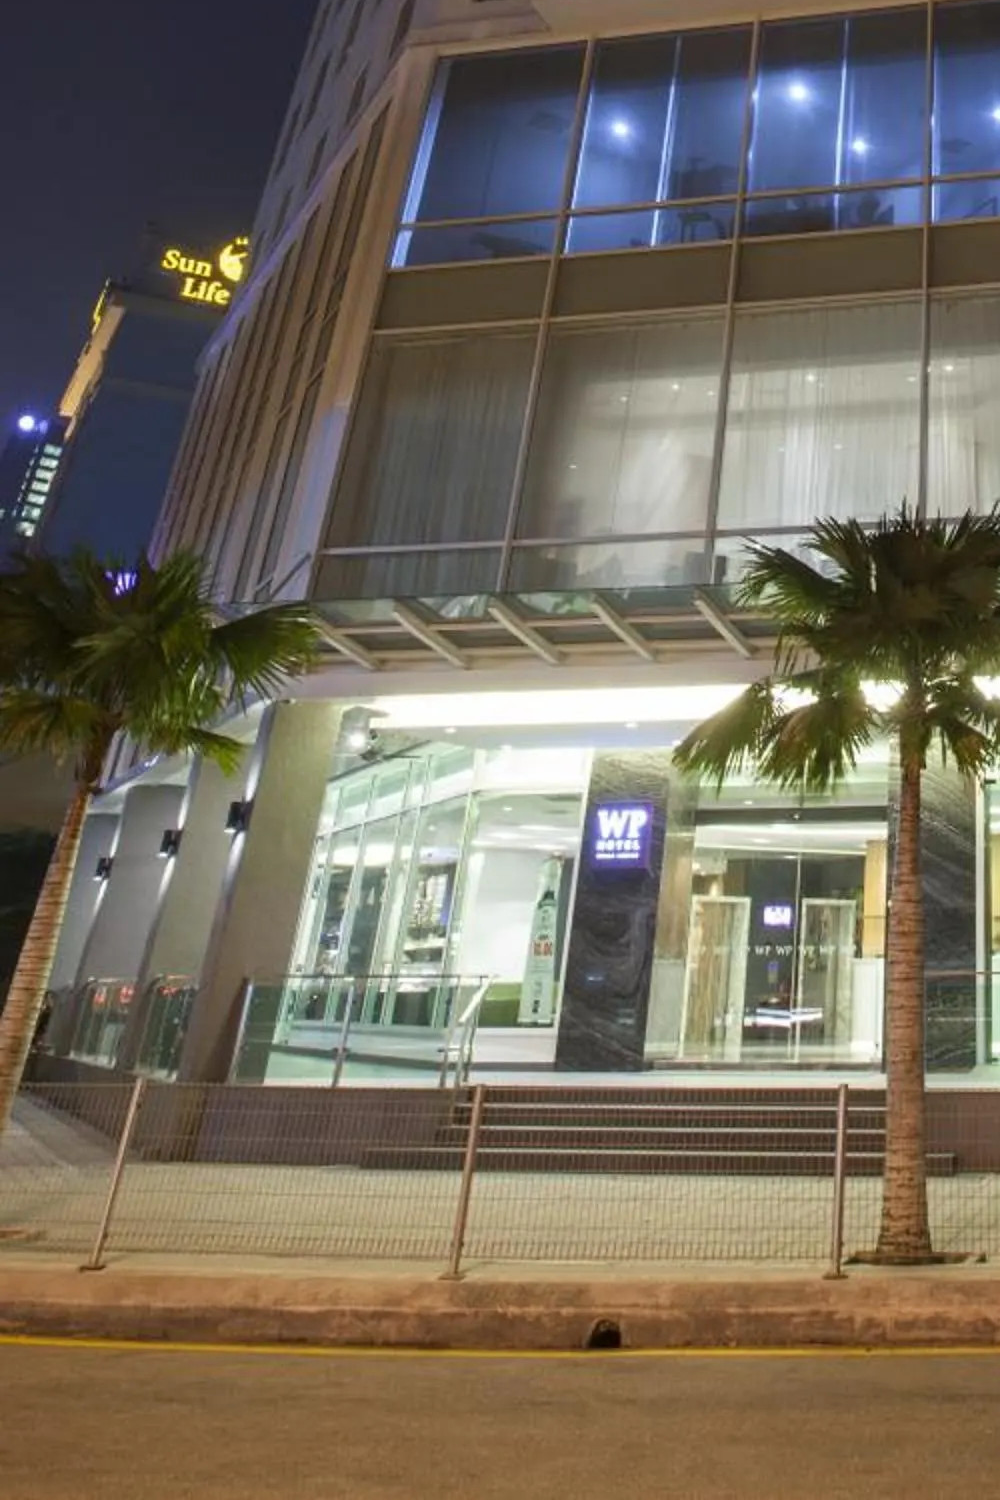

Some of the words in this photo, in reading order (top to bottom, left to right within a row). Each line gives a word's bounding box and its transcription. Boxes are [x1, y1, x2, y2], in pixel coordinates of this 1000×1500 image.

[162, 249, 212, 277] Sun
[182, 277, 231, 305] Life
[597, 809, 648, 838] WP
